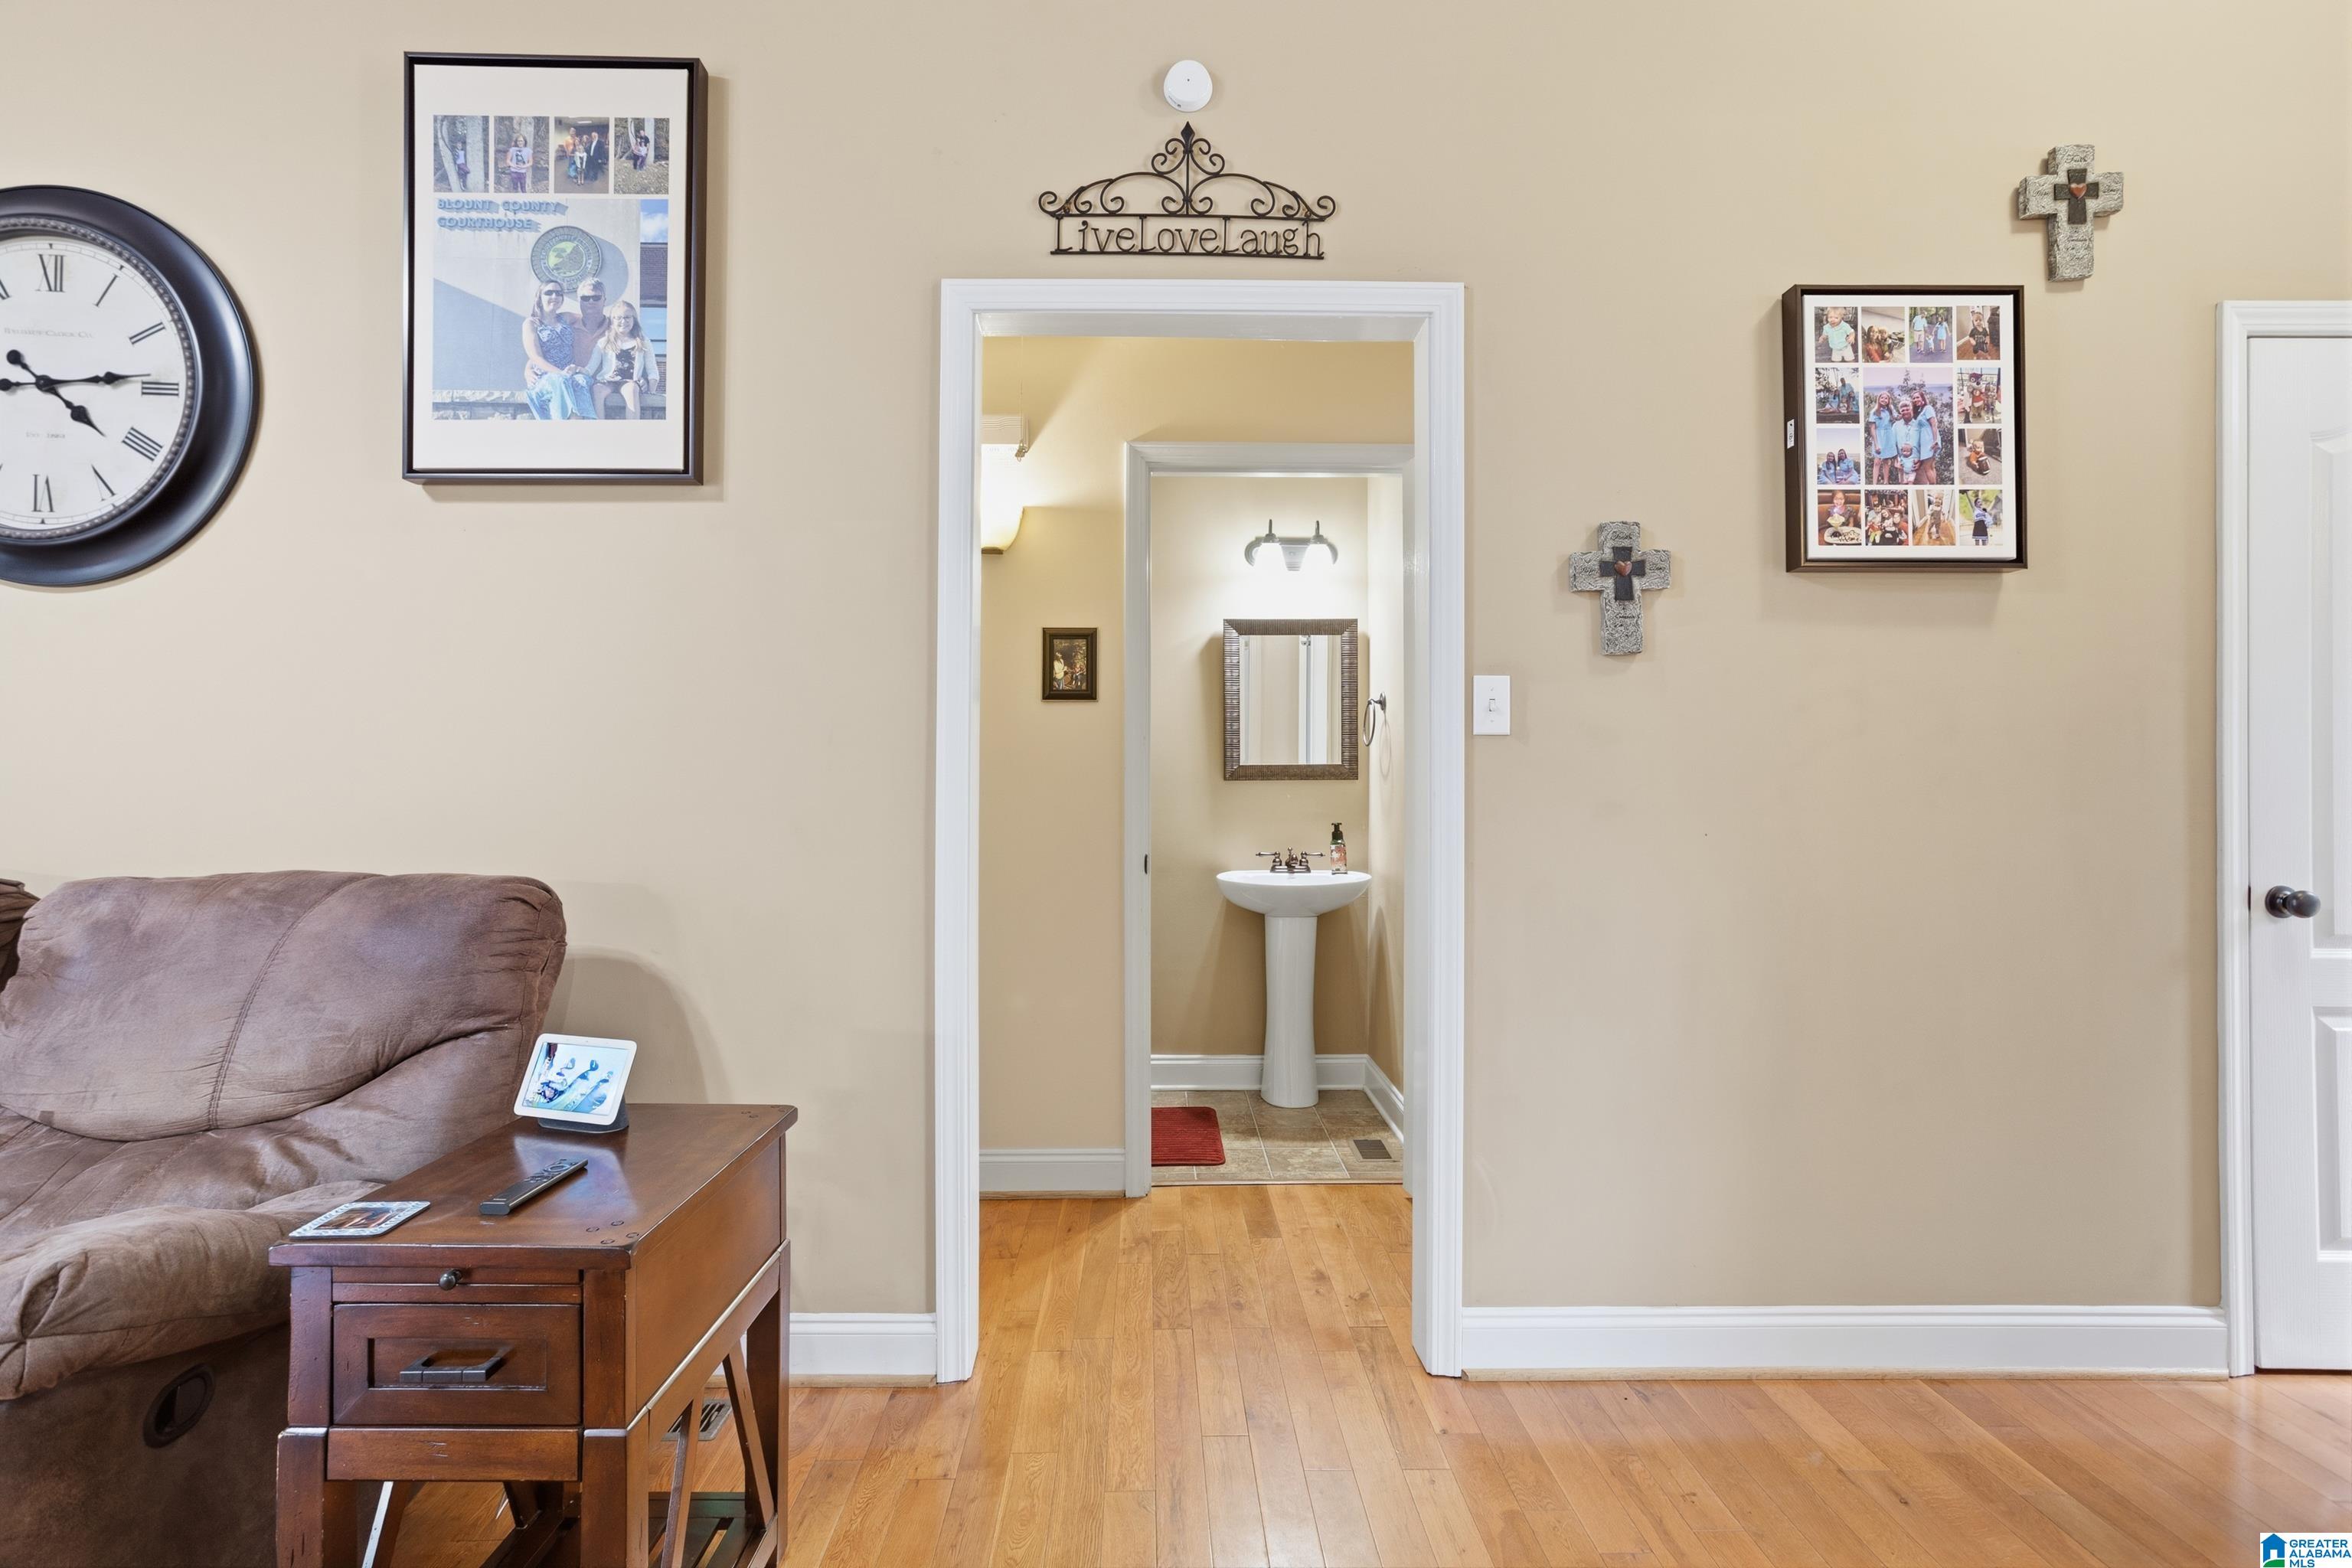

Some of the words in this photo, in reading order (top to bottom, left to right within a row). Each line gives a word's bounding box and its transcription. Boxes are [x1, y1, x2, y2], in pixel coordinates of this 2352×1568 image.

[437, 198, 492, 211] BLOUNT
[501, 200, 559, 213] COUNTY
[437, 217, 533, 230] COURTHOUSE
[35, 253, 67, 292] XII
